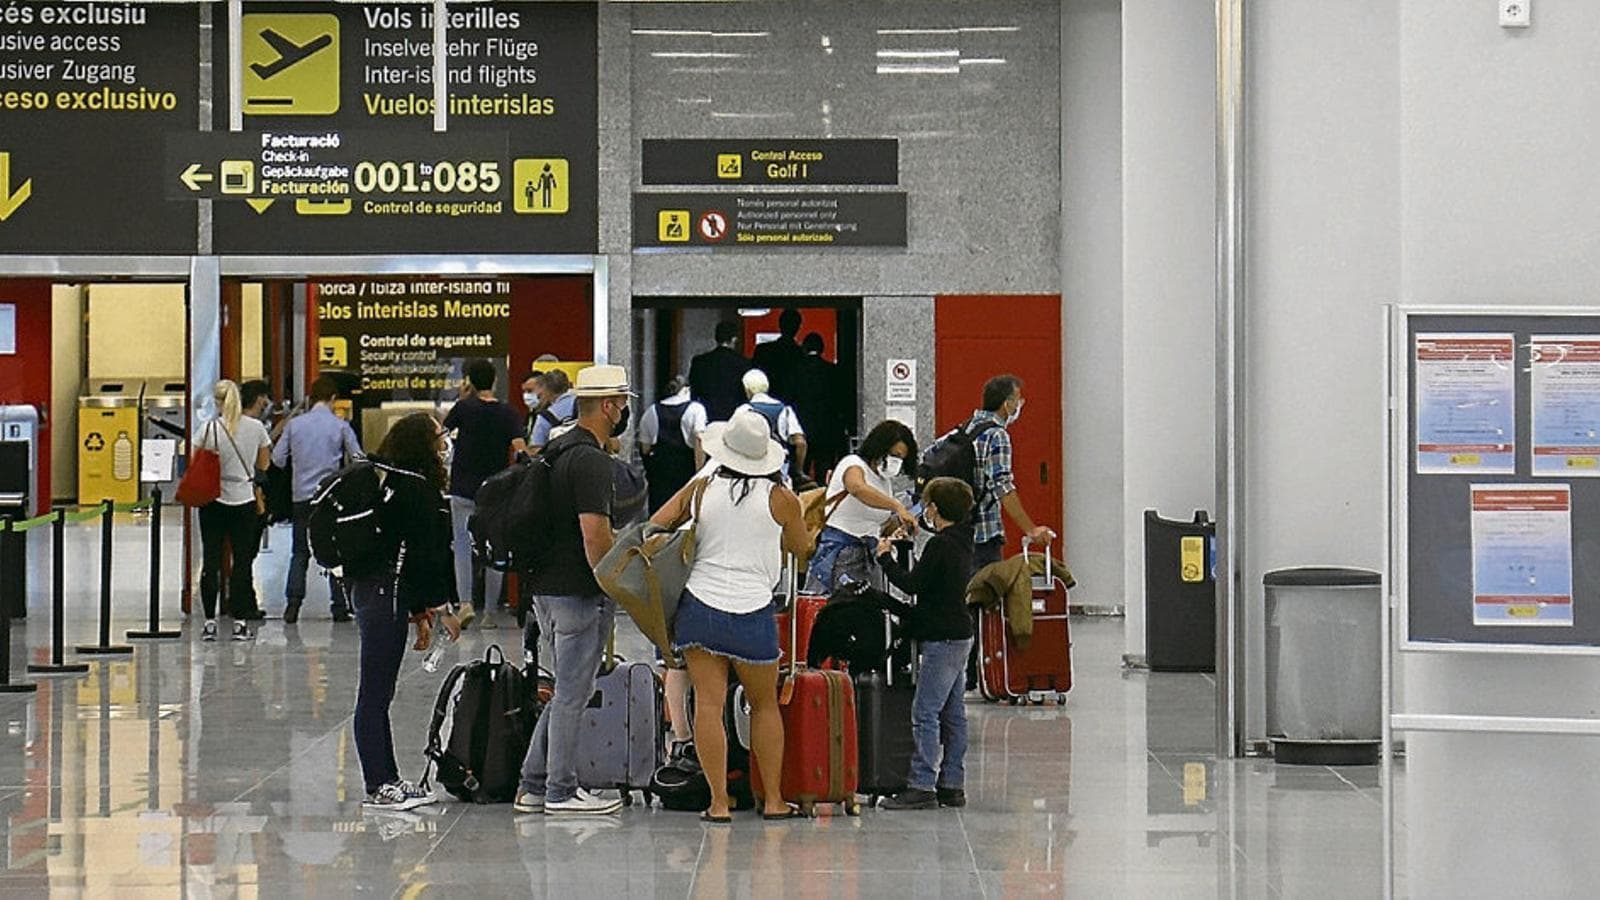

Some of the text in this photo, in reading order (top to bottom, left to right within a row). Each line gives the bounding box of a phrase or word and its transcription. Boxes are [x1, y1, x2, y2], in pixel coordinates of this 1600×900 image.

[0, 1, 147, 24] és exclusiu
[364, 7, 412, 29] Vols
[50, 35, 121, 51] access
[486, 38, 538, 60] Flüge
[62, 59, 136, 84] Zugang
[365, 65, 537, 87] Inter-islnd flights
[0, 87, 177, 110] eso exclusivo
[364, 93, 554, 115] Vuelos interislas
[261, 133, 340, 148] Facturació
[261, 150, 310, 163] Check-in
[751, 150, 824, 161] Control Acceso
[261, 165, 349, 180] Gepäckaufgabe
[353, 161, 501, 192] 001 to 085
[767, 163, 799, 178] Golf
[261, 180, 350, 194] Facturación
[363, 201, 502, 216] Control de seguridad
[766, 199, 800, 209] personal
[756, 233, 790, 243] personal
[357, 301, 438, 319] interislas
[444, 300, 510, 318] Menorc
[360, 334, 492, 349] Control de seguretat
[360, 350, 437, 362] Security control
[362, 376, 408, 390] Control
[410, 376, 427, 389] de
